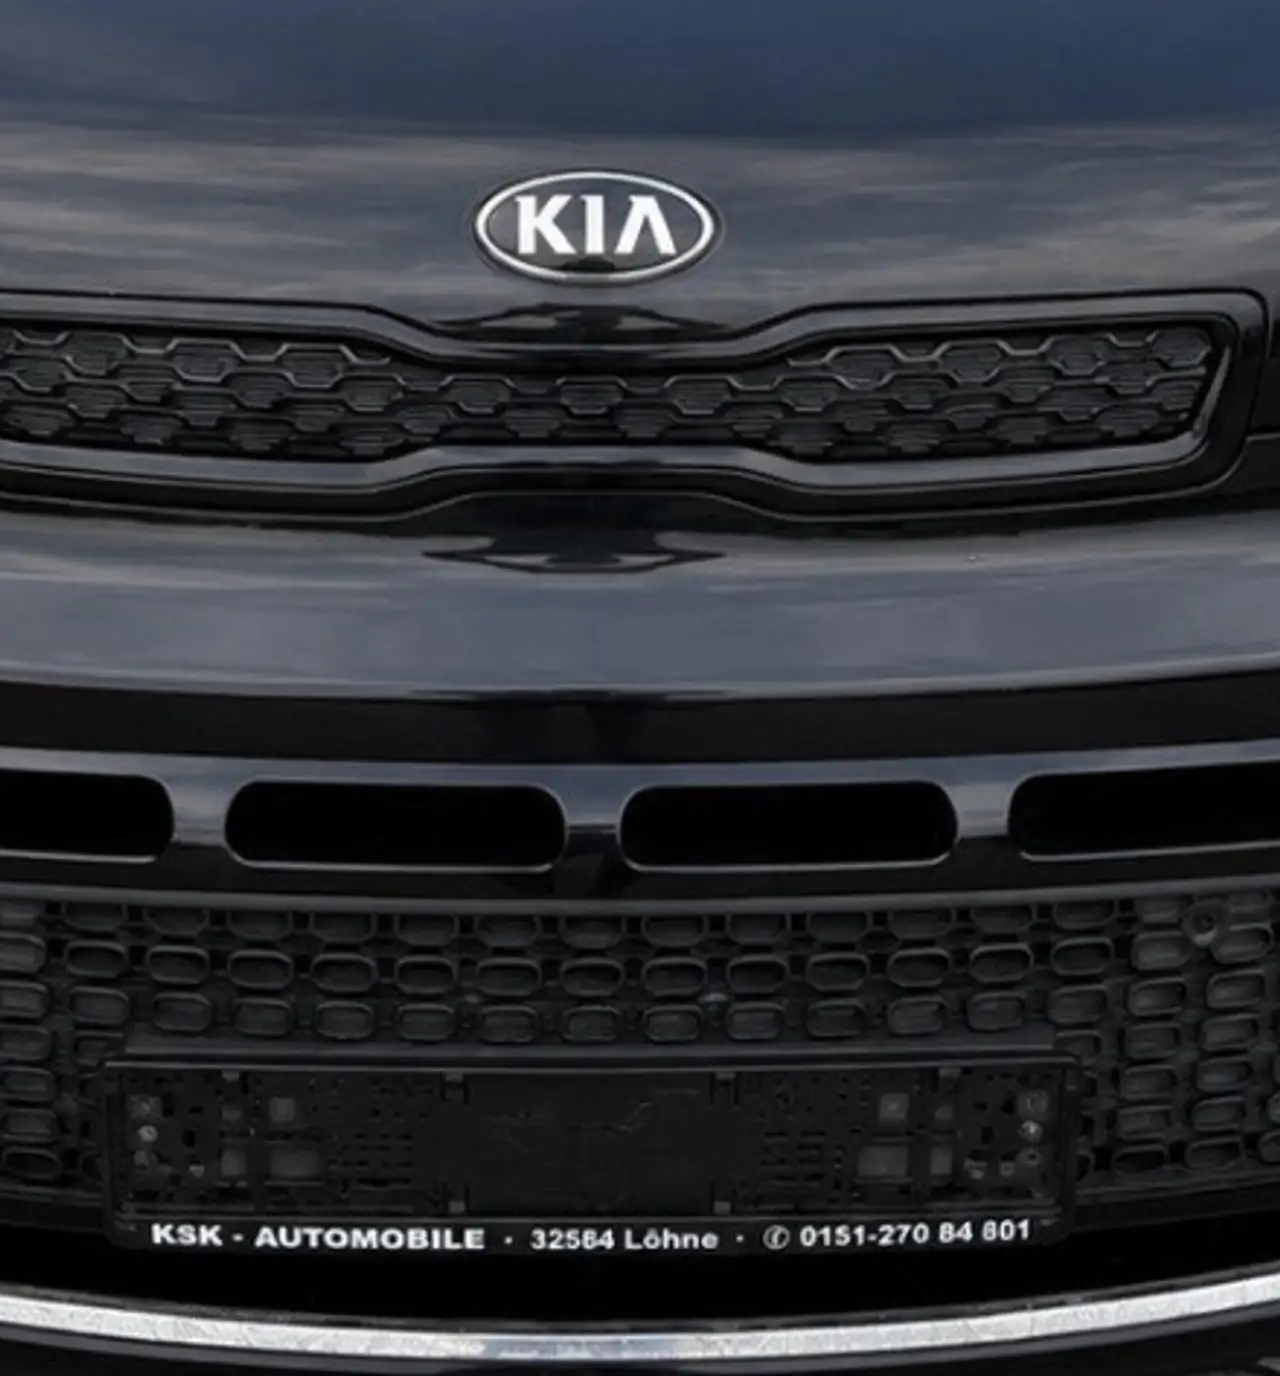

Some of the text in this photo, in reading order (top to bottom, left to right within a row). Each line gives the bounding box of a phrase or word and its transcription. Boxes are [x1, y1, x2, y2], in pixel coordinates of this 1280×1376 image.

[515, 194, 677, 254] KIA
[151, 1223, 223, 1247] KSK
[254, 1226, 485, 1250] AUTOMOBILE
[531, 1227, 615, 1250] 32584
[624, 1227, 719, 1250] Löhne
[799, 1222, 930, 1247] 0151-270
[939, 1221, 973, 1244] 84
[982, 1218, 1030, 1241] 801
